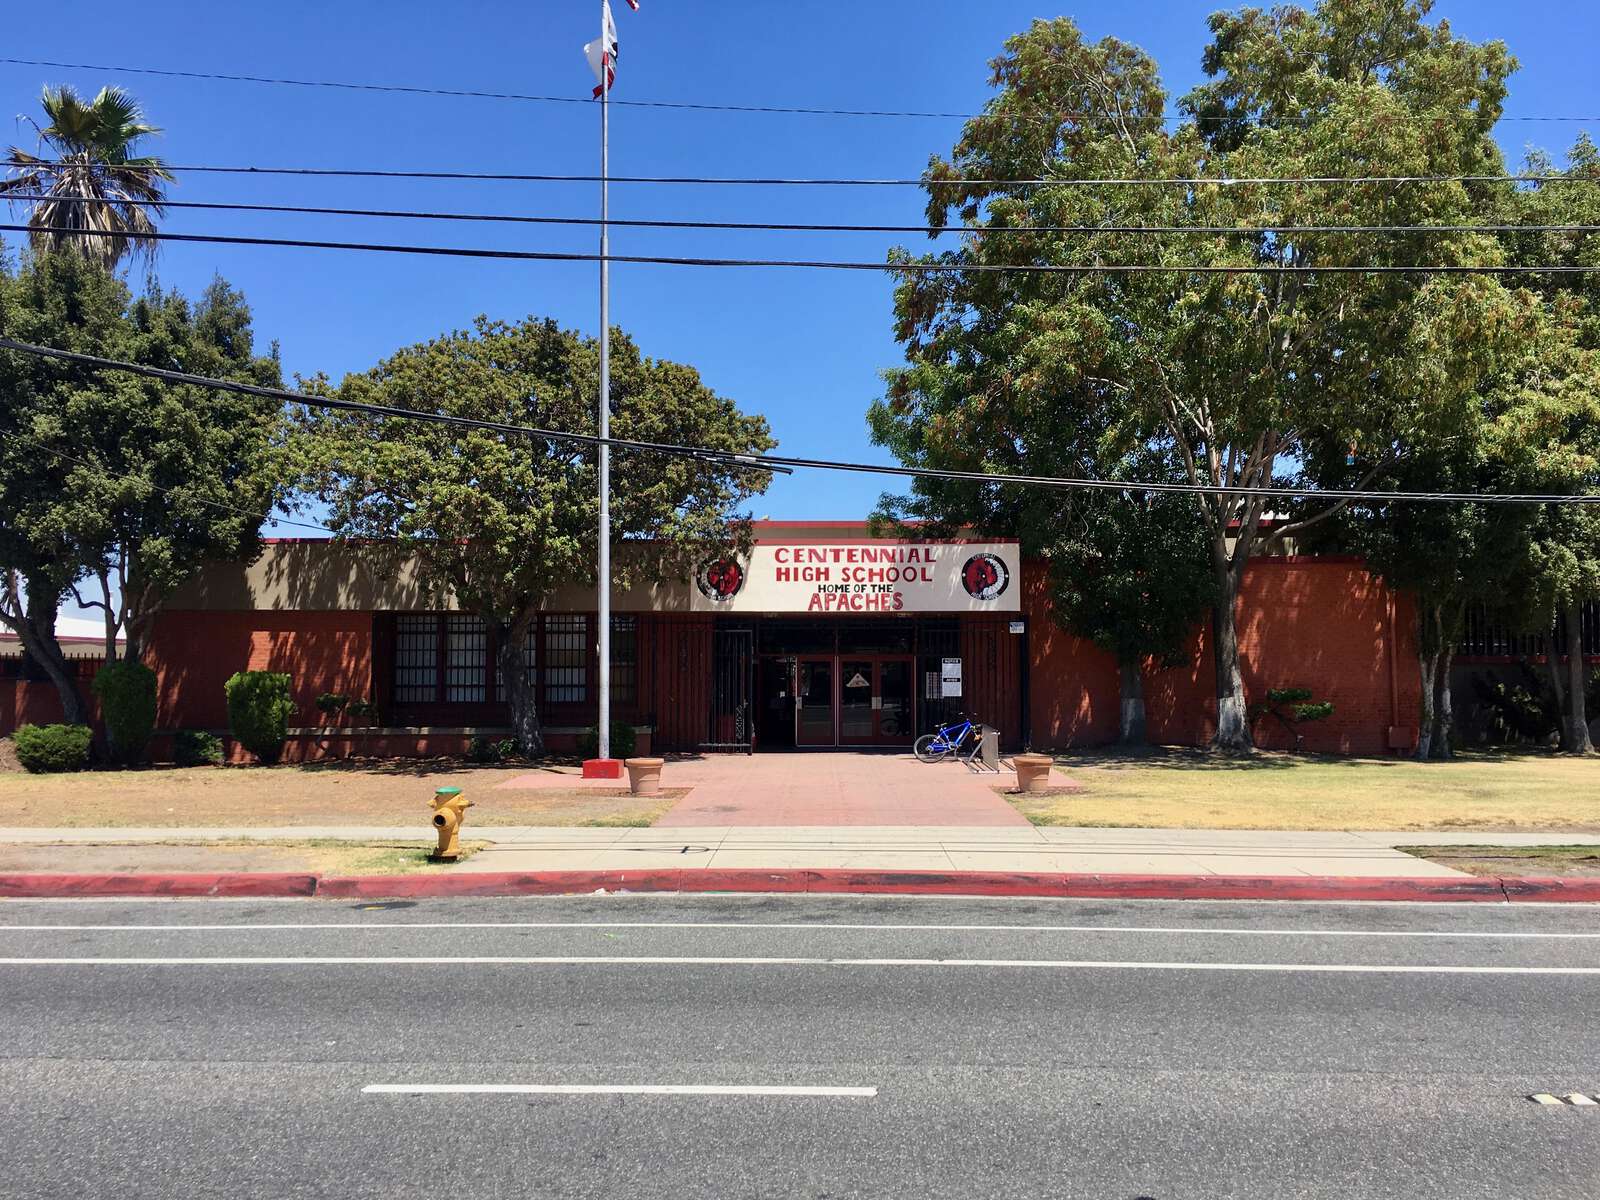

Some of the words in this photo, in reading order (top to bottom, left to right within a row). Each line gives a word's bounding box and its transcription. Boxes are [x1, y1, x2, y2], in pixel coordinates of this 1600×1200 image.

[774, 547, 936, 563] CENTENNIAL
[776, 567, 830, 582] HIGH
[841, 566, 933, 583] SCHOOL
[818, 584, 850, 593] HOME
[854, 584, 867, 593] OF
[870, 584, 893, 593] THE
[808, 592, 904, 611] APACHES
